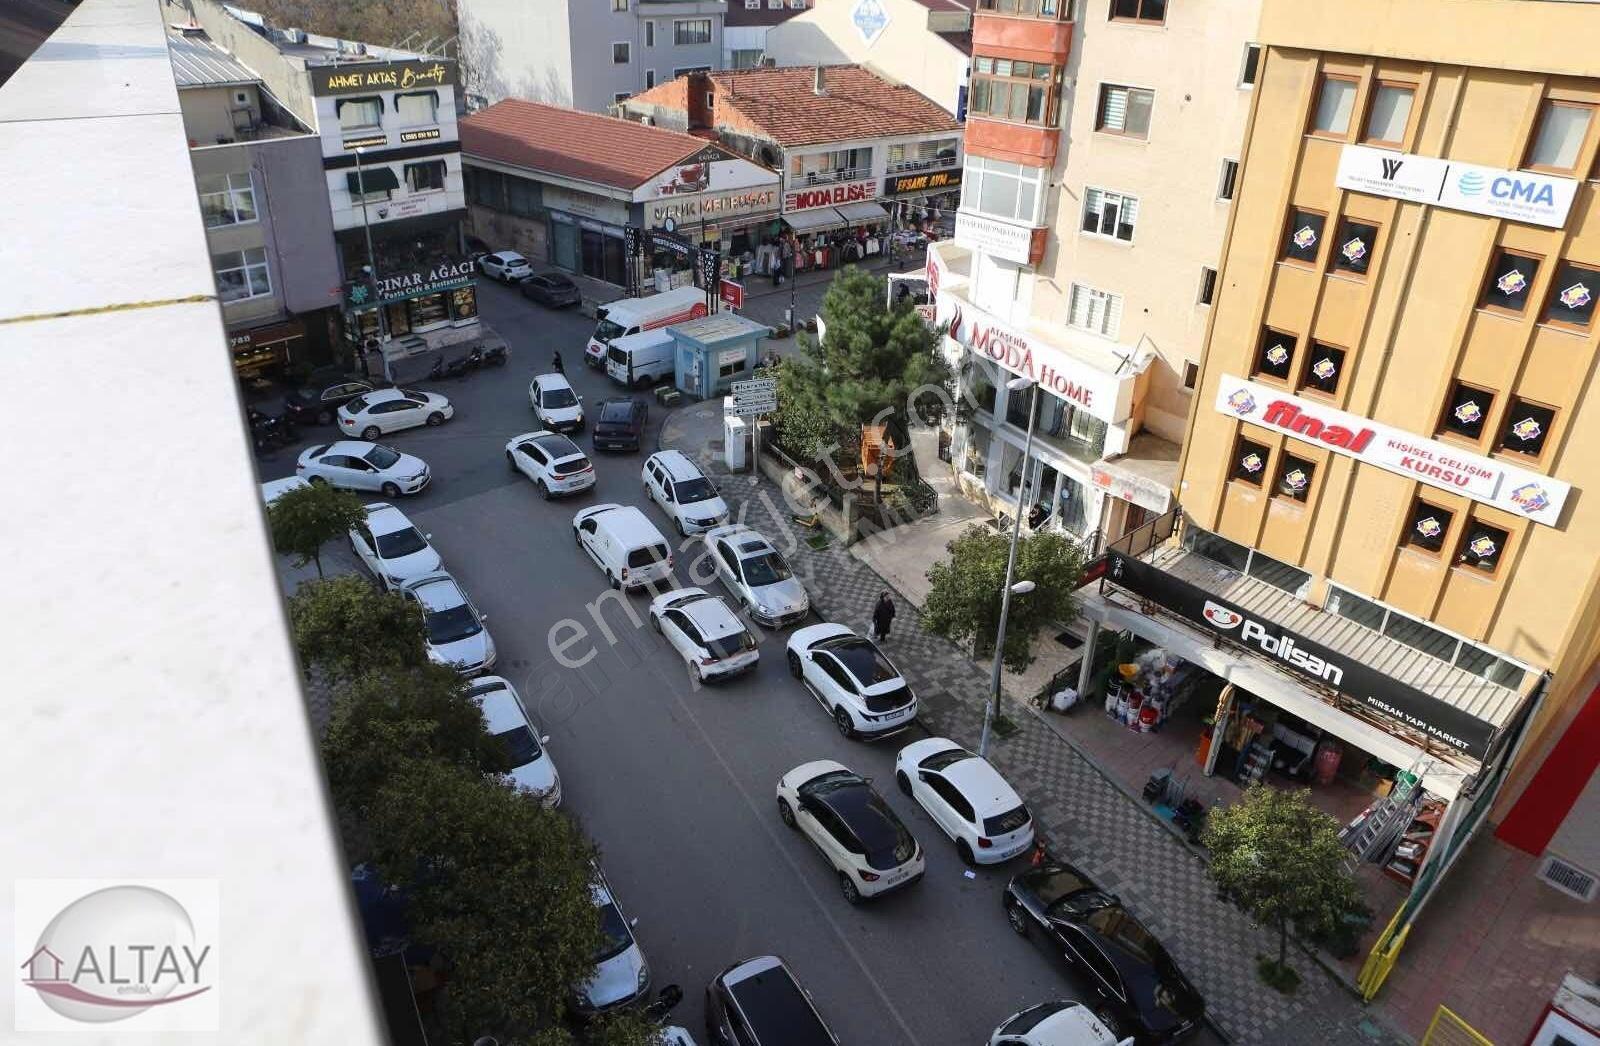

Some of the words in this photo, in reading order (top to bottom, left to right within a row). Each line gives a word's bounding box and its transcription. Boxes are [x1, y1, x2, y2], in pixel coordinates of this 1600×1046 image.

[328, 74, 364, 89] AHMET
[367, 71, 398, 87] AKTAŞ
[796, 189, 832, 210] MODA
[833, 183, 866, 203] ELİSA
[1491, 177, 1554, 206] CMA
[429, 261, 475, 281] AĞACI
[970, 321, 1035, 378] MODA
[1040, 363, 1093, 407] HOME
[1263, 400, 1376, 454] final
[1400, 456, 1470, 488] KURSU
[1241, 619, 1344, 686] Polisan
[1404, 714, 1427, 731] YAPI
[1427, 725, 1470, 750] MARKET
